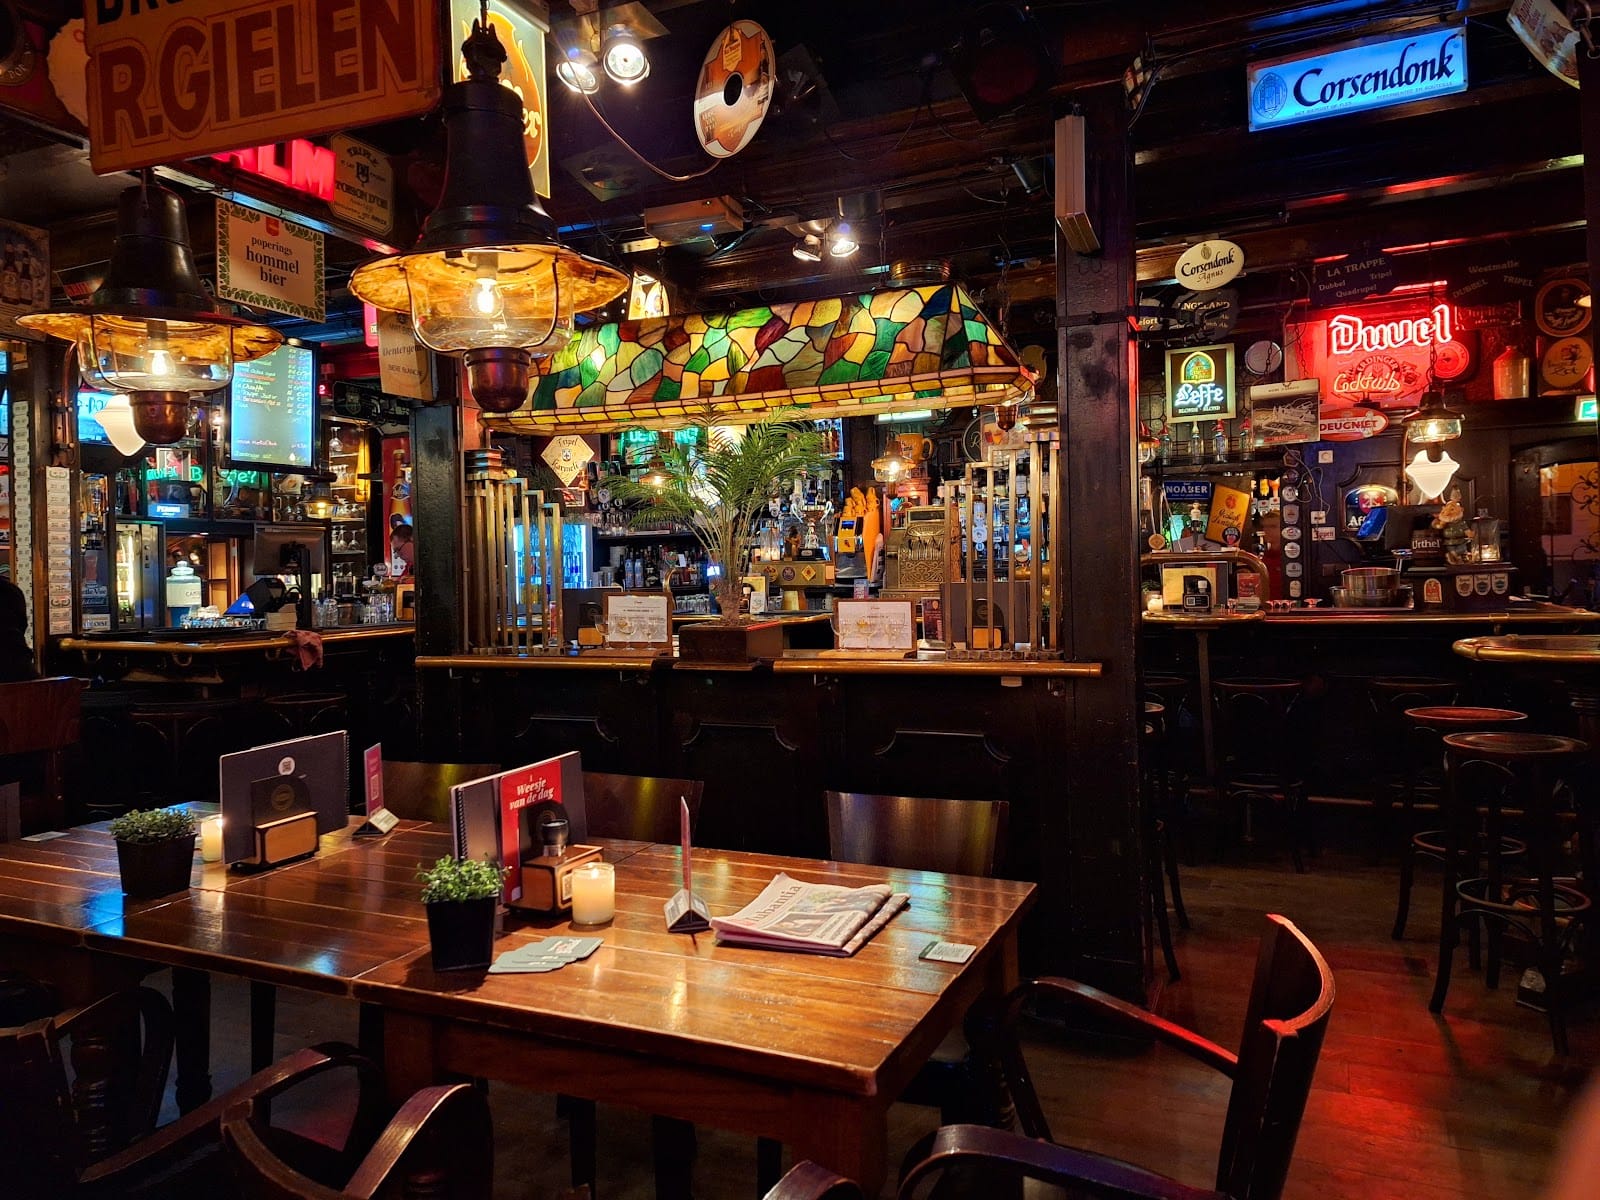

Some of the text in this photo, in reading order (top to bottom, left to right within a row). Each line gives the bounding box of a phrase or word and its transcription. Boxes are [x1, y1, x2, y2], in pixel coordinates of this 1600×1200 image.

[1293, 34, 1462, 107] Corsendonk
[251, 237, 293, 255] poperings
[246, 245, 299, 274] hommel
[1181, 247, 1235, 277] Corsendonk
[1327, 257, 1386, 278] LA TRAPPE
[260, 266, 287, 287] bier
[1197, 268, 1224, 284] Agnus
[1369, 268, 1393, 281] Tripel
[1502, 273, 1535, 288] TRIPEL
[1318, 279, 1346, 292] Dubbel
[1335, 284, 1378, 298] Quadrupel
[1452, 278, 1489, 299] DUBBEL
[1330, 304, 1452, 354] Duvel
[1357, 355, 1399, 372] ERDINGER
[1334, 371, 1401, 392] Cocktails
[1174, 383, 1224, 407] Leffe
[1320, 419, 1378, 432] DEUGNIET
[1412, 538, 1441, 549] Urthel
[516, 777, 547, 796] Weesje
[509, 787, 555, 810] van de dag
